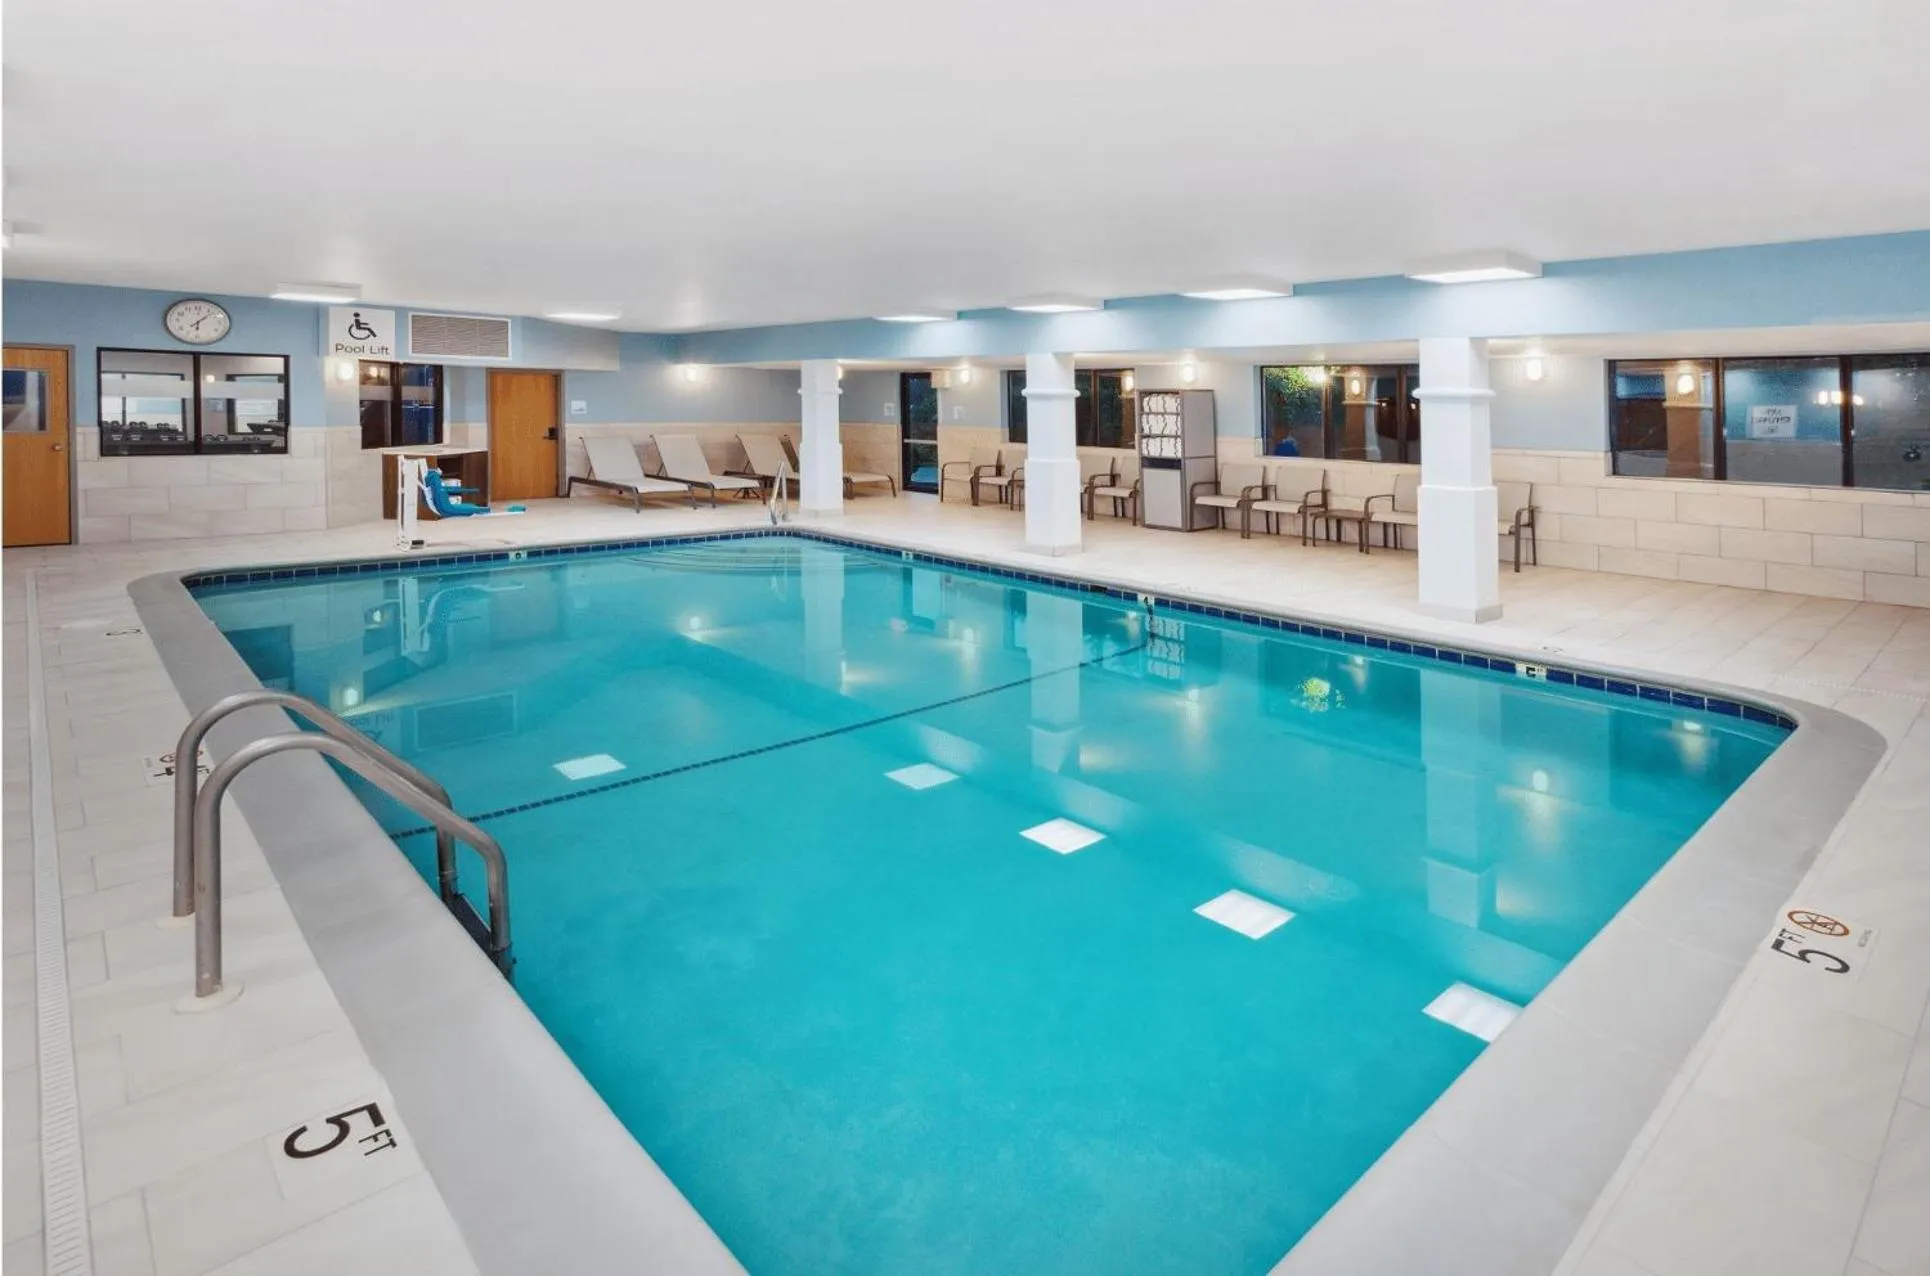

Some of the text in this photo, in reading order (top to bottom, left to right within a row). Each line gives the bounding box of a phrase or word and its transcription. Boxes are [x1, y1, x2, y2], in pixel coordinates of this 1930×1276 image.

[335, 343, 390, 355] Pool Lift
[1770, 938, 1850, 974] 5
[283, 1102, 397, 1159] 5 FT
